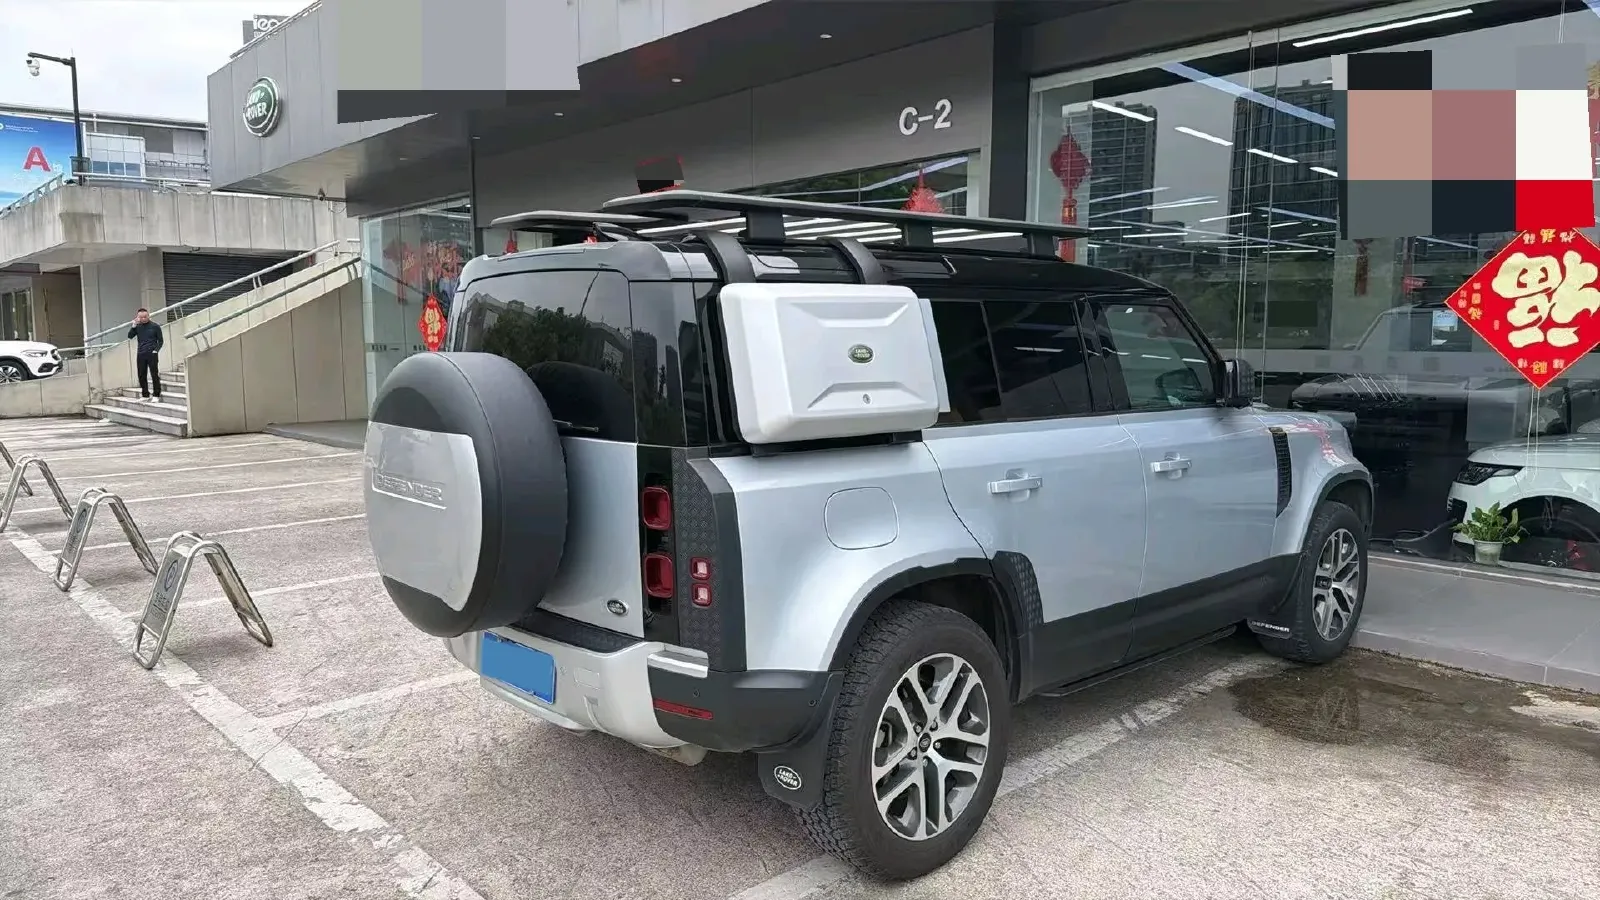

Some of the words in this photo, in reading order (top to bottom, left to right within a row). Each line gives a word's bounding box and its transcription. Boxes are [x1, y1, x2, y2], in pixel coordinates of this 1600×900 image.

[246, 101, 267, 121] ROVER
[899, 98, 952, 136] C-2
[23, 146, 51, 172] A
[1491, 250, 1600, 348] 福
[374, 473, 443, 501] DEFENDER
[1251, 620, 1290, 633] DEFENDER
[779, 768, 793, 779] LAND
[780, 774, 798, 787] ROVER
